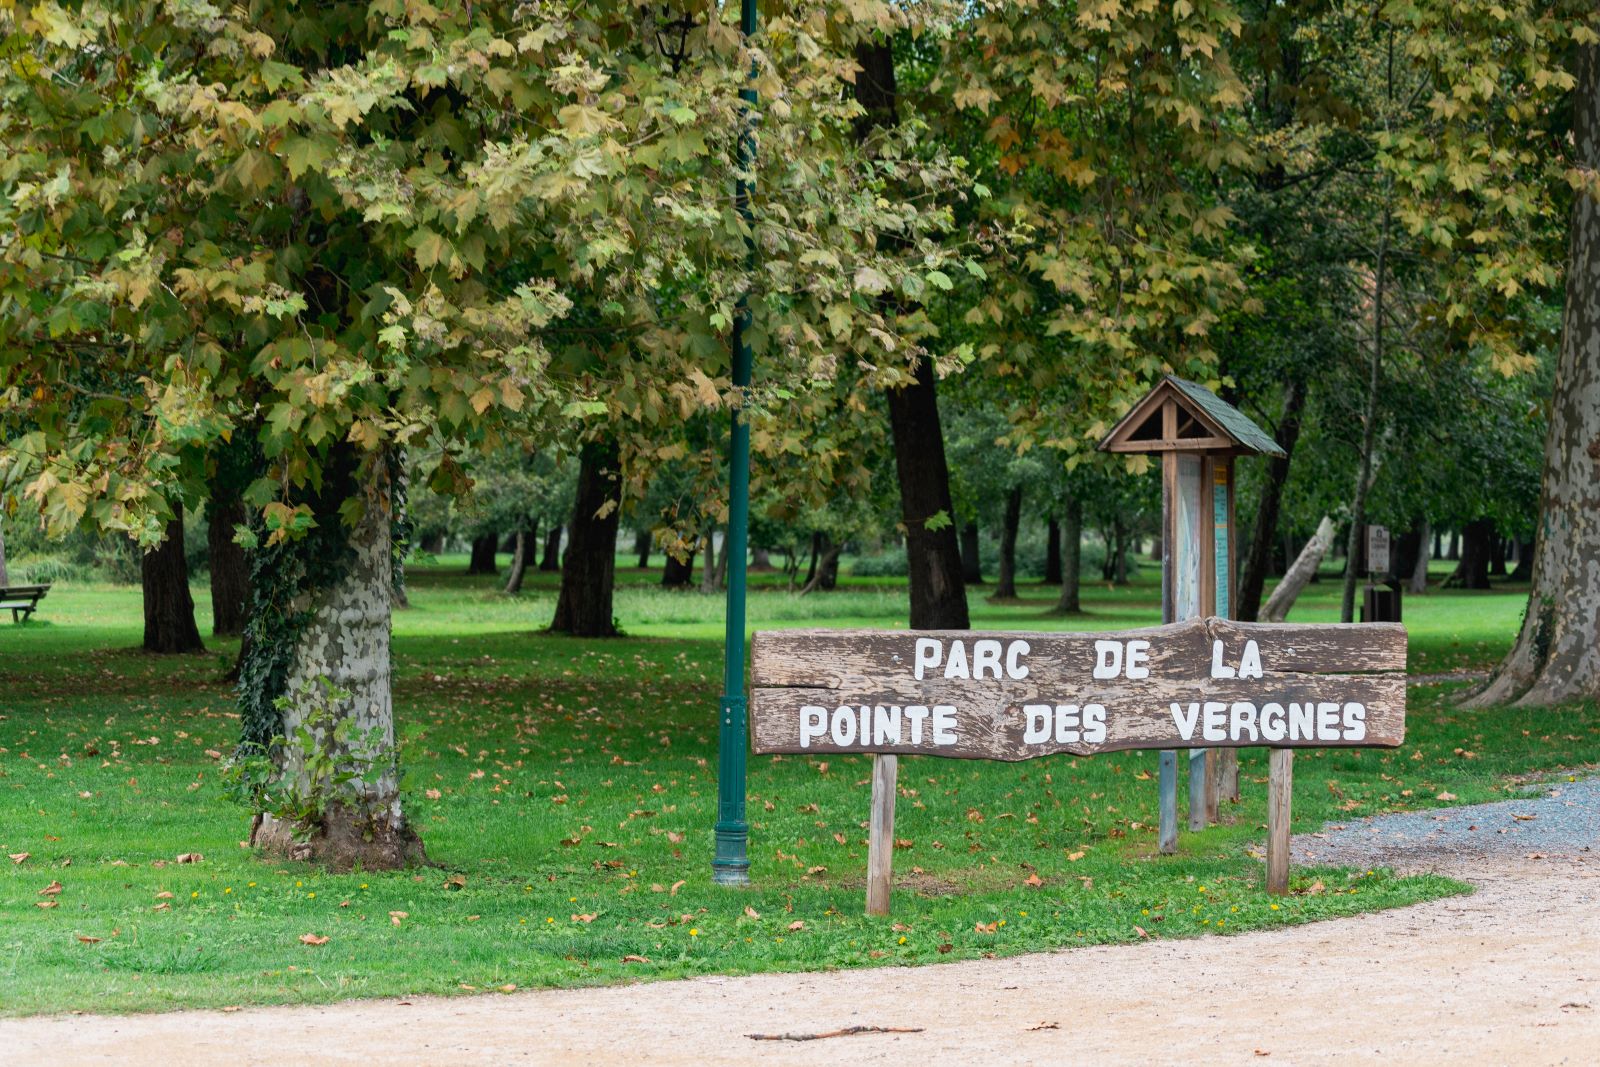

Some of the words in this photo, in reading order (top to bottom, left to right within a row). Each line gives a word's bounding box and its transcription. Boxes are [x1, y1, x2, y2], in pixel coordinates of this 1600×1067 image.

[914, 637, 1031, 681] PARC
[1092, 639, 1151, 680] DE
[1210, 639, 1264, 680] LA
[799, 704, 959, 748] POINTE
[1022, 703, 1107, 745] DES
[1169, 701, 1367, 742] VERGNES
